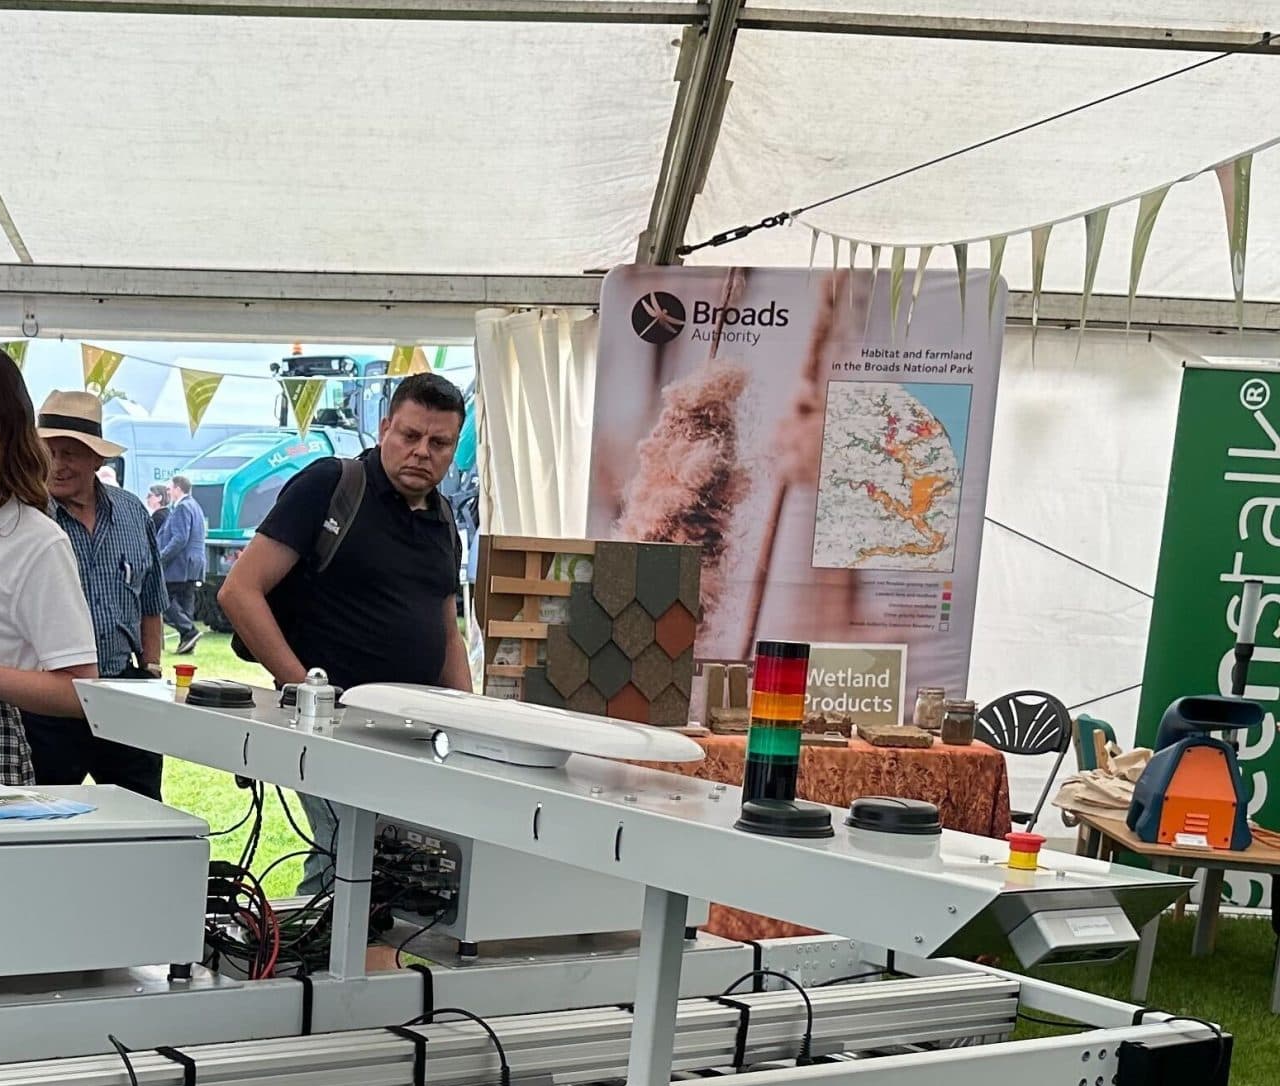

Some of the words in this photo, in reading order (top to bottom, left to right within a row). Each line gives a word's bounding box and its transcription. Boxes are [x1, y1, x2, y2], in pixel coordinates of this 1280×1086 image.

[693, 301, 789, 327] Broads
[692, 328, 761, 347] Authority
[861, 348, 900, 359] Habitat
[903, 349, 922, 360] and
[926, 349, 973, 361] farmland
[832, 361, 841, 371] in
[845, 362, 861, 371] the
[864, 362, 900, 373] Broads
[904, 364, 947, 374] National
[950, 365, 974, 375] Park
[805, 667, 890, 688] Wetland
[804, 693, 893, 713] Products
